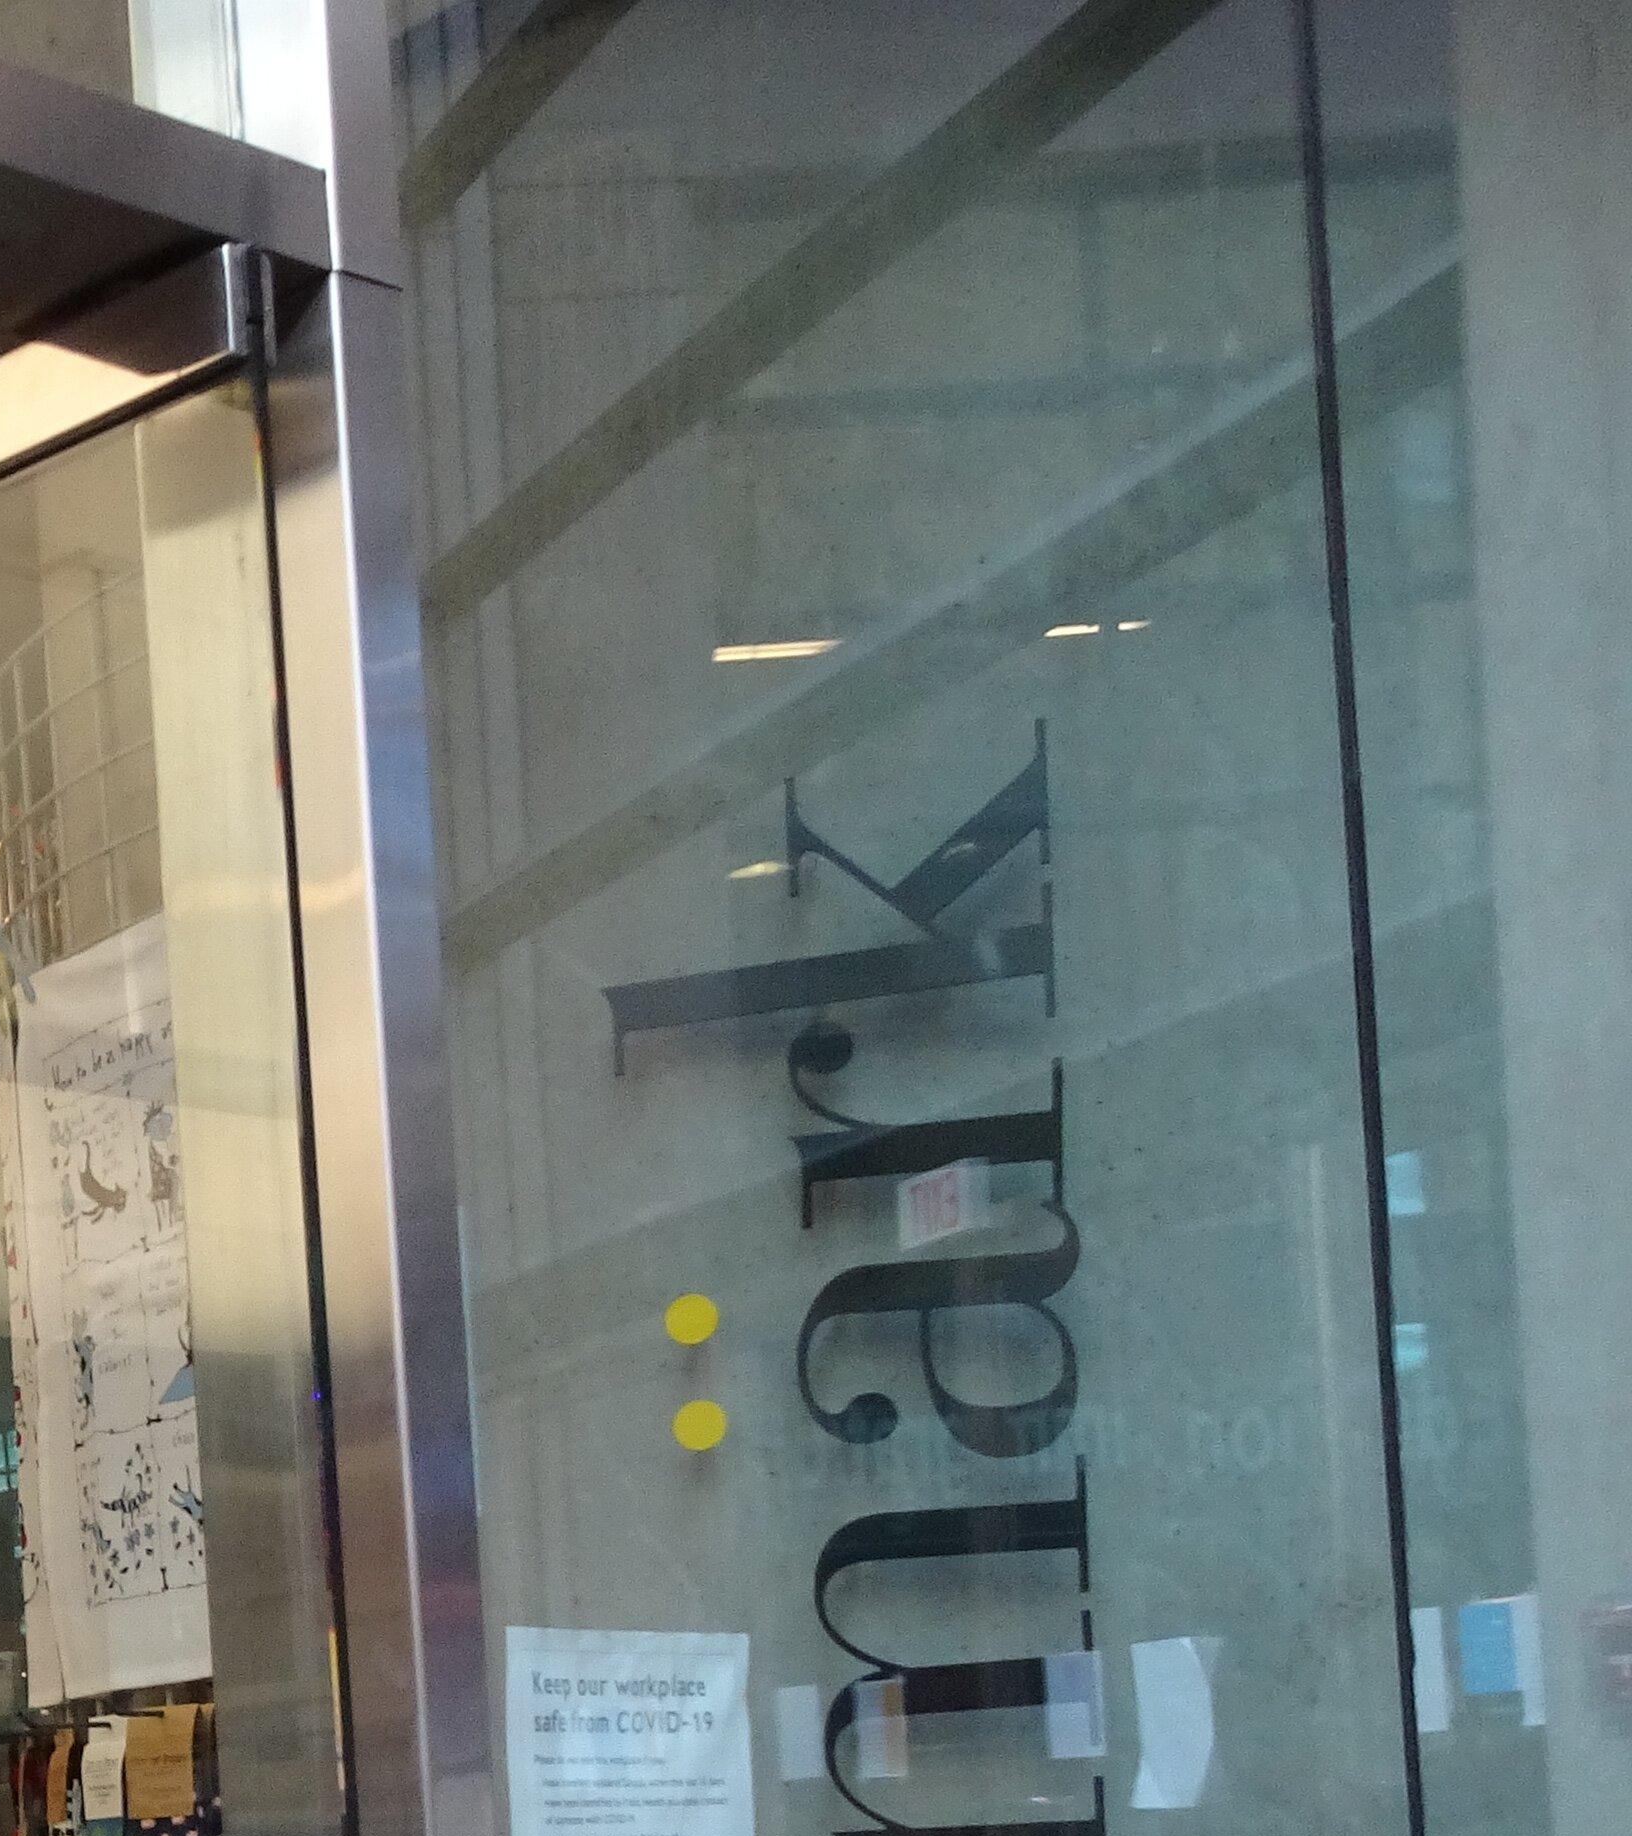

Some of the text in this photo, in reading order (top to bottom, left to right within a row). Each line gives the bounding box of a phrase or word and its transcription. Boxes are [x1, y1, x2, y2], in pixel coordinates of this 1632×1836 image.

[532, 1671, 706, 1700] Keep our workplace
[534, 1709, 713, 1733] safe from COVID-19
